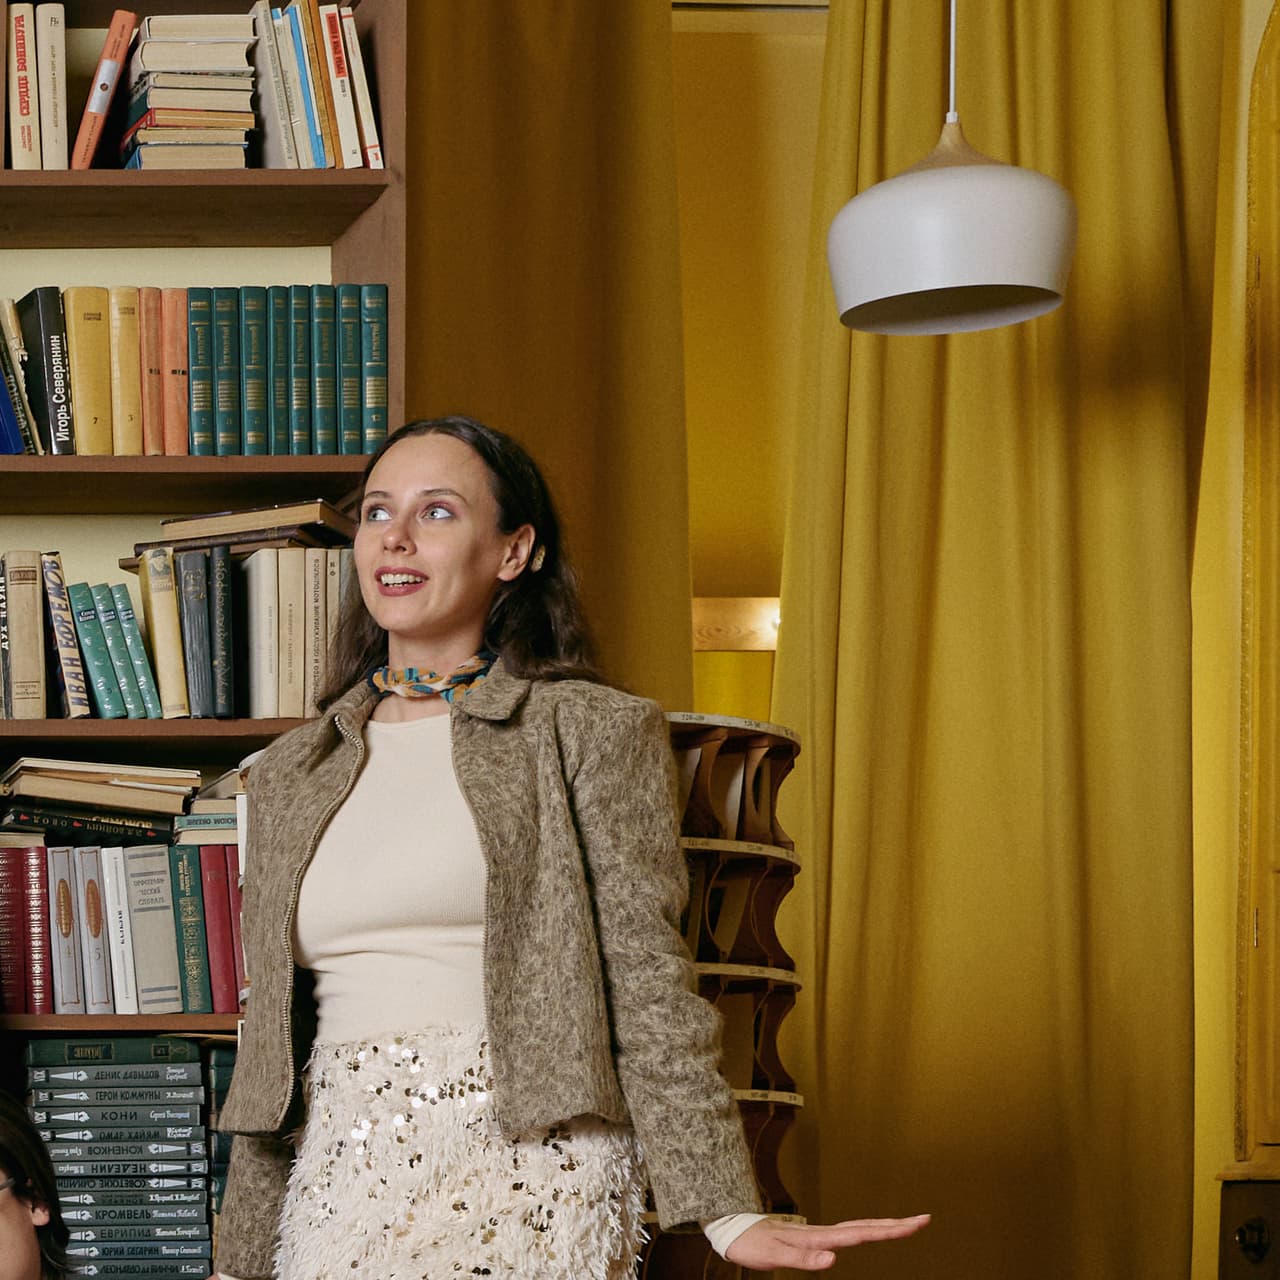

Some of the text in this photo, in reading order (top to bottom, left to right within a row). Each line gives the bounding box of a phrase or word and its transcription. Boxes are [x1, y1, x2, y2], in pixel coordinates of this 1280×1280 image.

[18, 75, 31, 117] СЕРДЦЕ
[50, 335, 70, 442] Игорь Северянин
[48, 558, 78, 649] ЕФРЕМОВ
[1, 624, 9, 650] ДУХ
[65, 653, 90, 707] ИВАН
[94, 1070, 160, 1081] ДЕНИС ДАВЫДОВ
[95, 1090, 118, 1100] ГЕРОИ
[120, 1090, 161, 1100] КОММУНЫ
[100, 1111, 138, 1121] КОНИ
[99, 1131, 124, 1140] ОМАР
[128, 1130, 160, 1140] ХАЙЯМ
[87, 1145, 144, 1156] КОНЕНКОВ
[91, 1164, 147, 1174] НЕДЕЛИН
[95, 1209, 151, 1220] КРОМВЕЛЬ
[100, 1227, 151, 1238] ЕВРИПИД
[100, 1246, 124, 1256] ЮРИЙ
